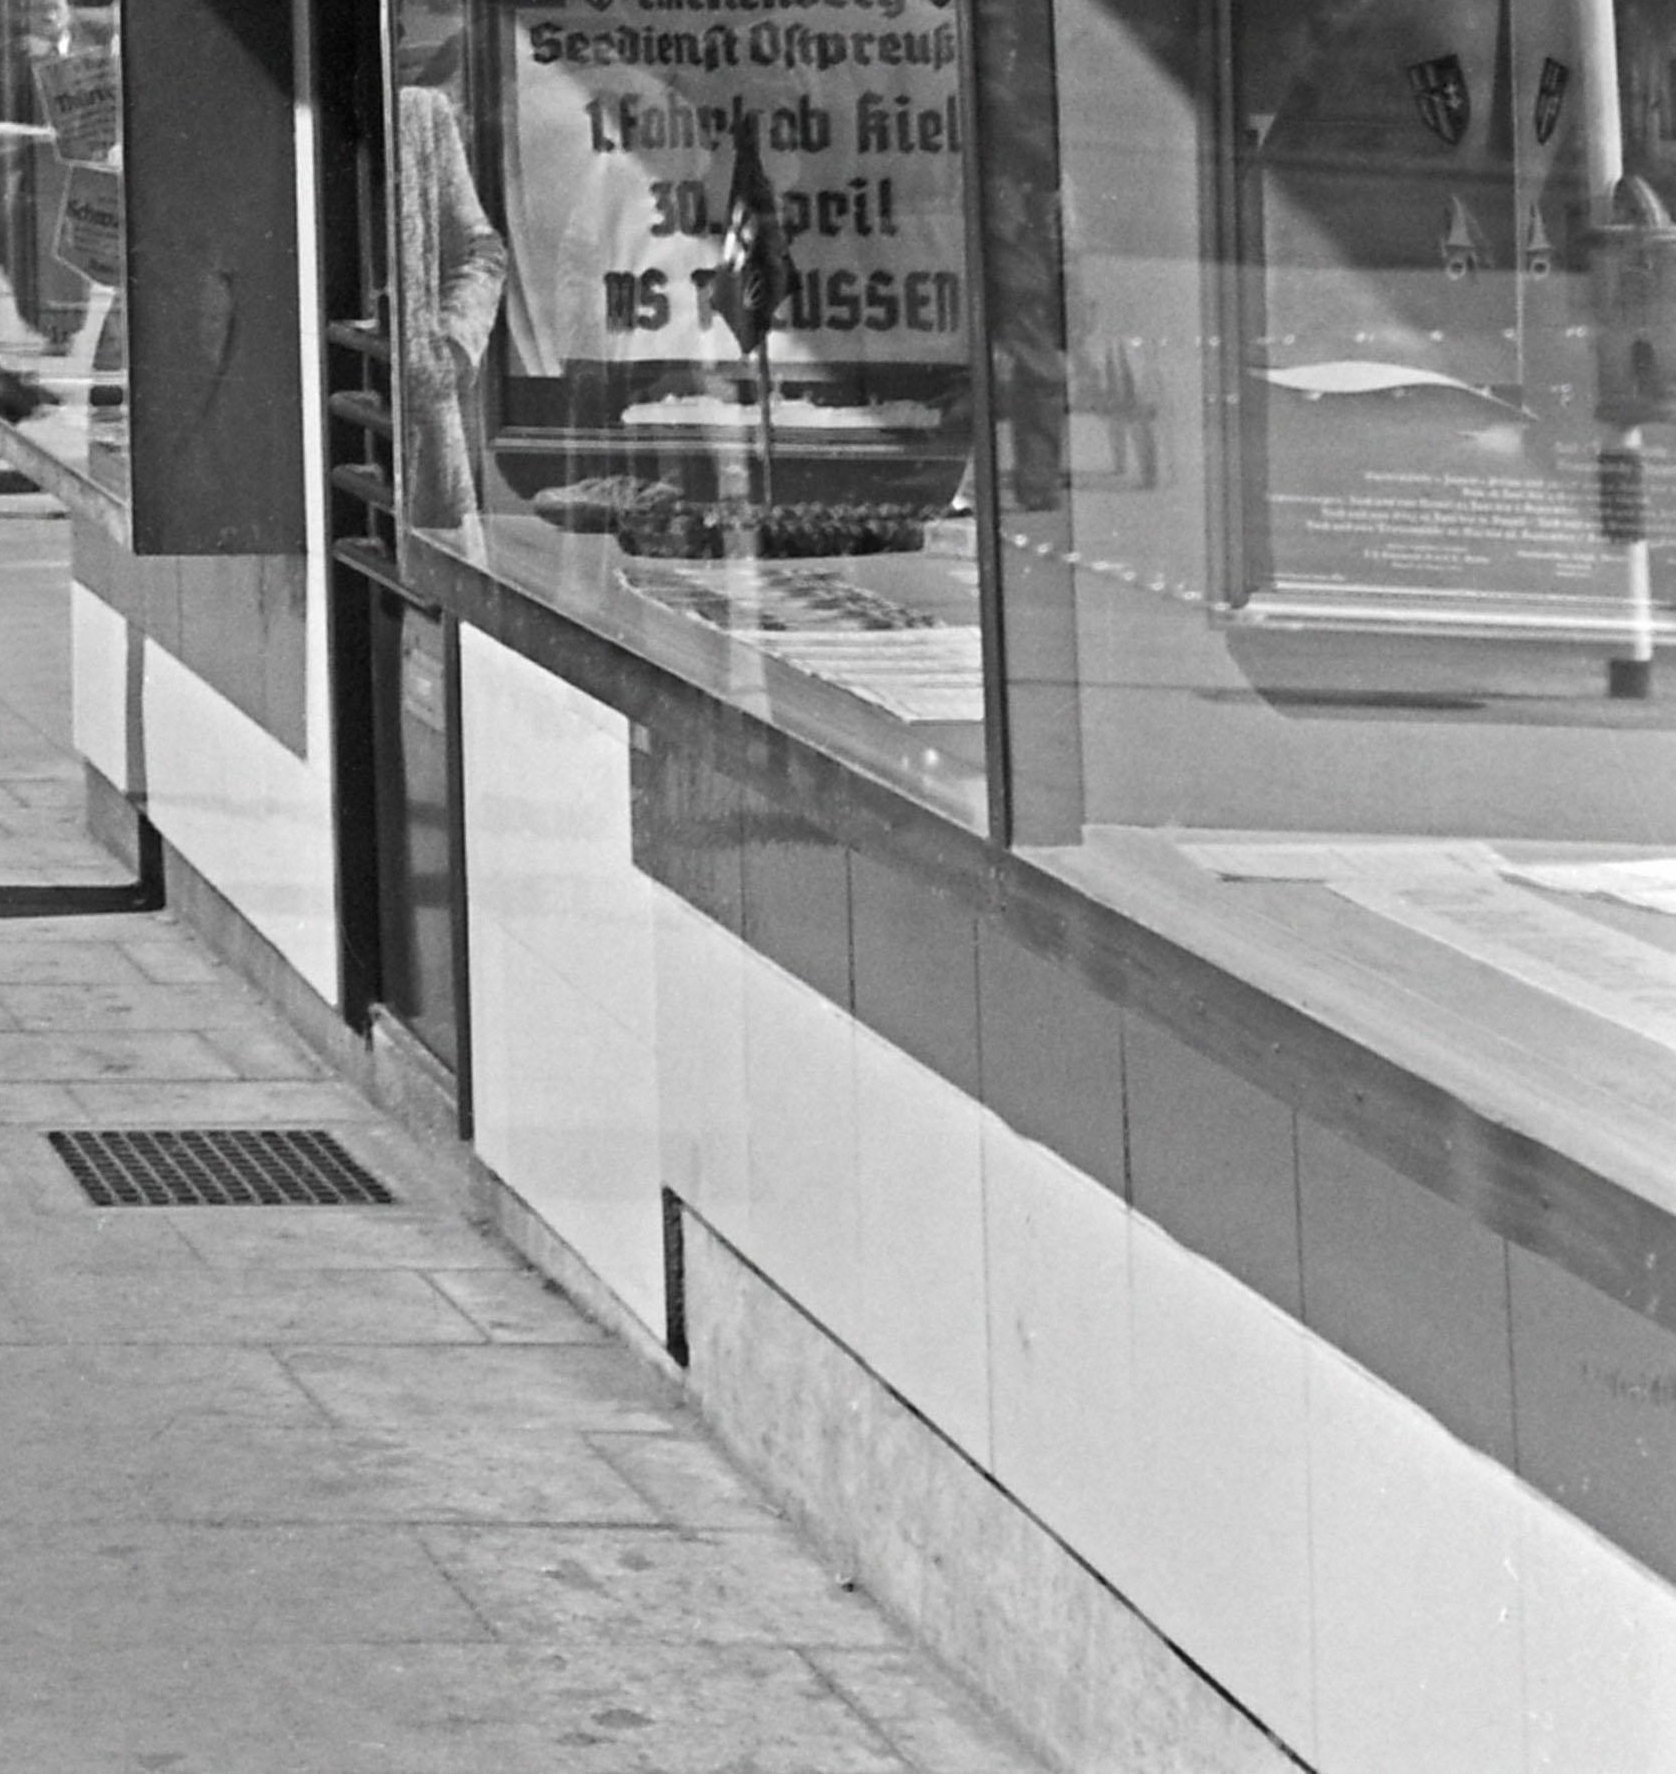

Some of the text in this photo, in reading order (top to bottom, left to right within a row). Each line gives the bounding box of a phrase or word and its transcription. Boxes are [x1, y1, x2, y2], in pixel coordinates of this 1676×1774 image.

[769, 93, 832, 154] ab
[856, 89, 962, 154] Kiel
[767, 176, 898, 239] pril
